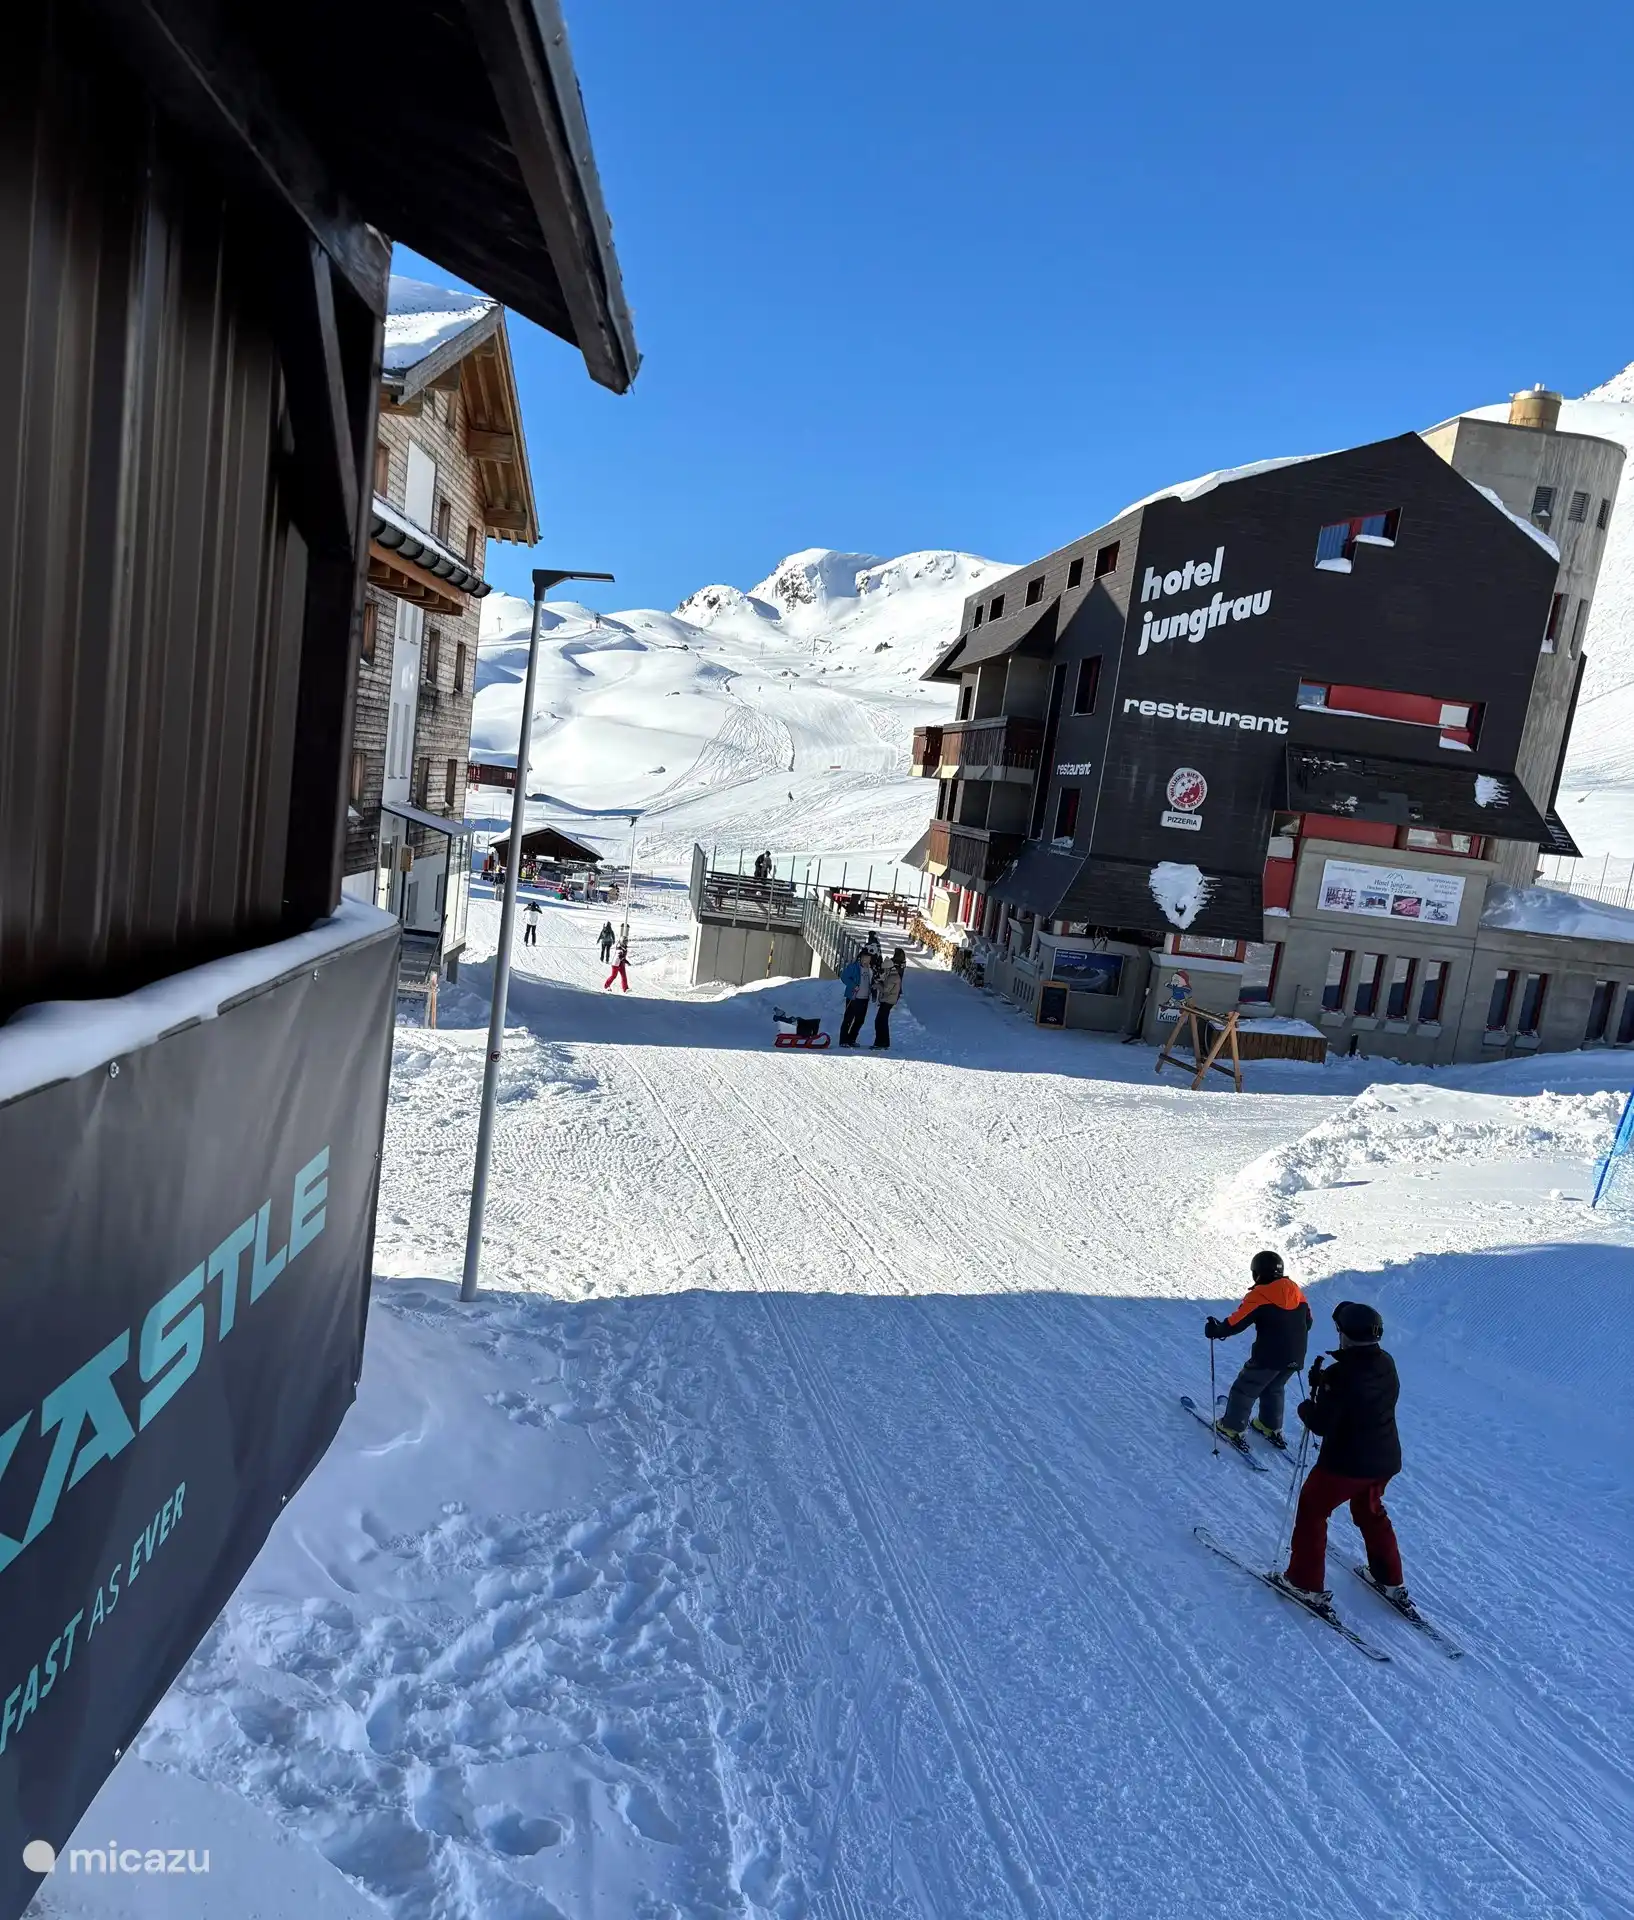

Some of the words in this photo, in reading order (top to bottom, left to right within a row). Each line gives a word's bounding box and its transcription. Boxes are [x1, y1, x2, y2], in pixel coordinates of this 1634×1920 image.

[1140, 546, 1225, 603] hotel
[1137, 590, 1272, 655] jungfrau
[1123, 698, 1289, 735] restaurant
[1056, 761, 1092, 776] restaurant
[1166, 816, 1198, 826] PIZZERIA
[0, 1608, 84, 1757] FAST
[87, 1563, 122, 1642] AS
[127, 1481, 187, 1588] EVER
